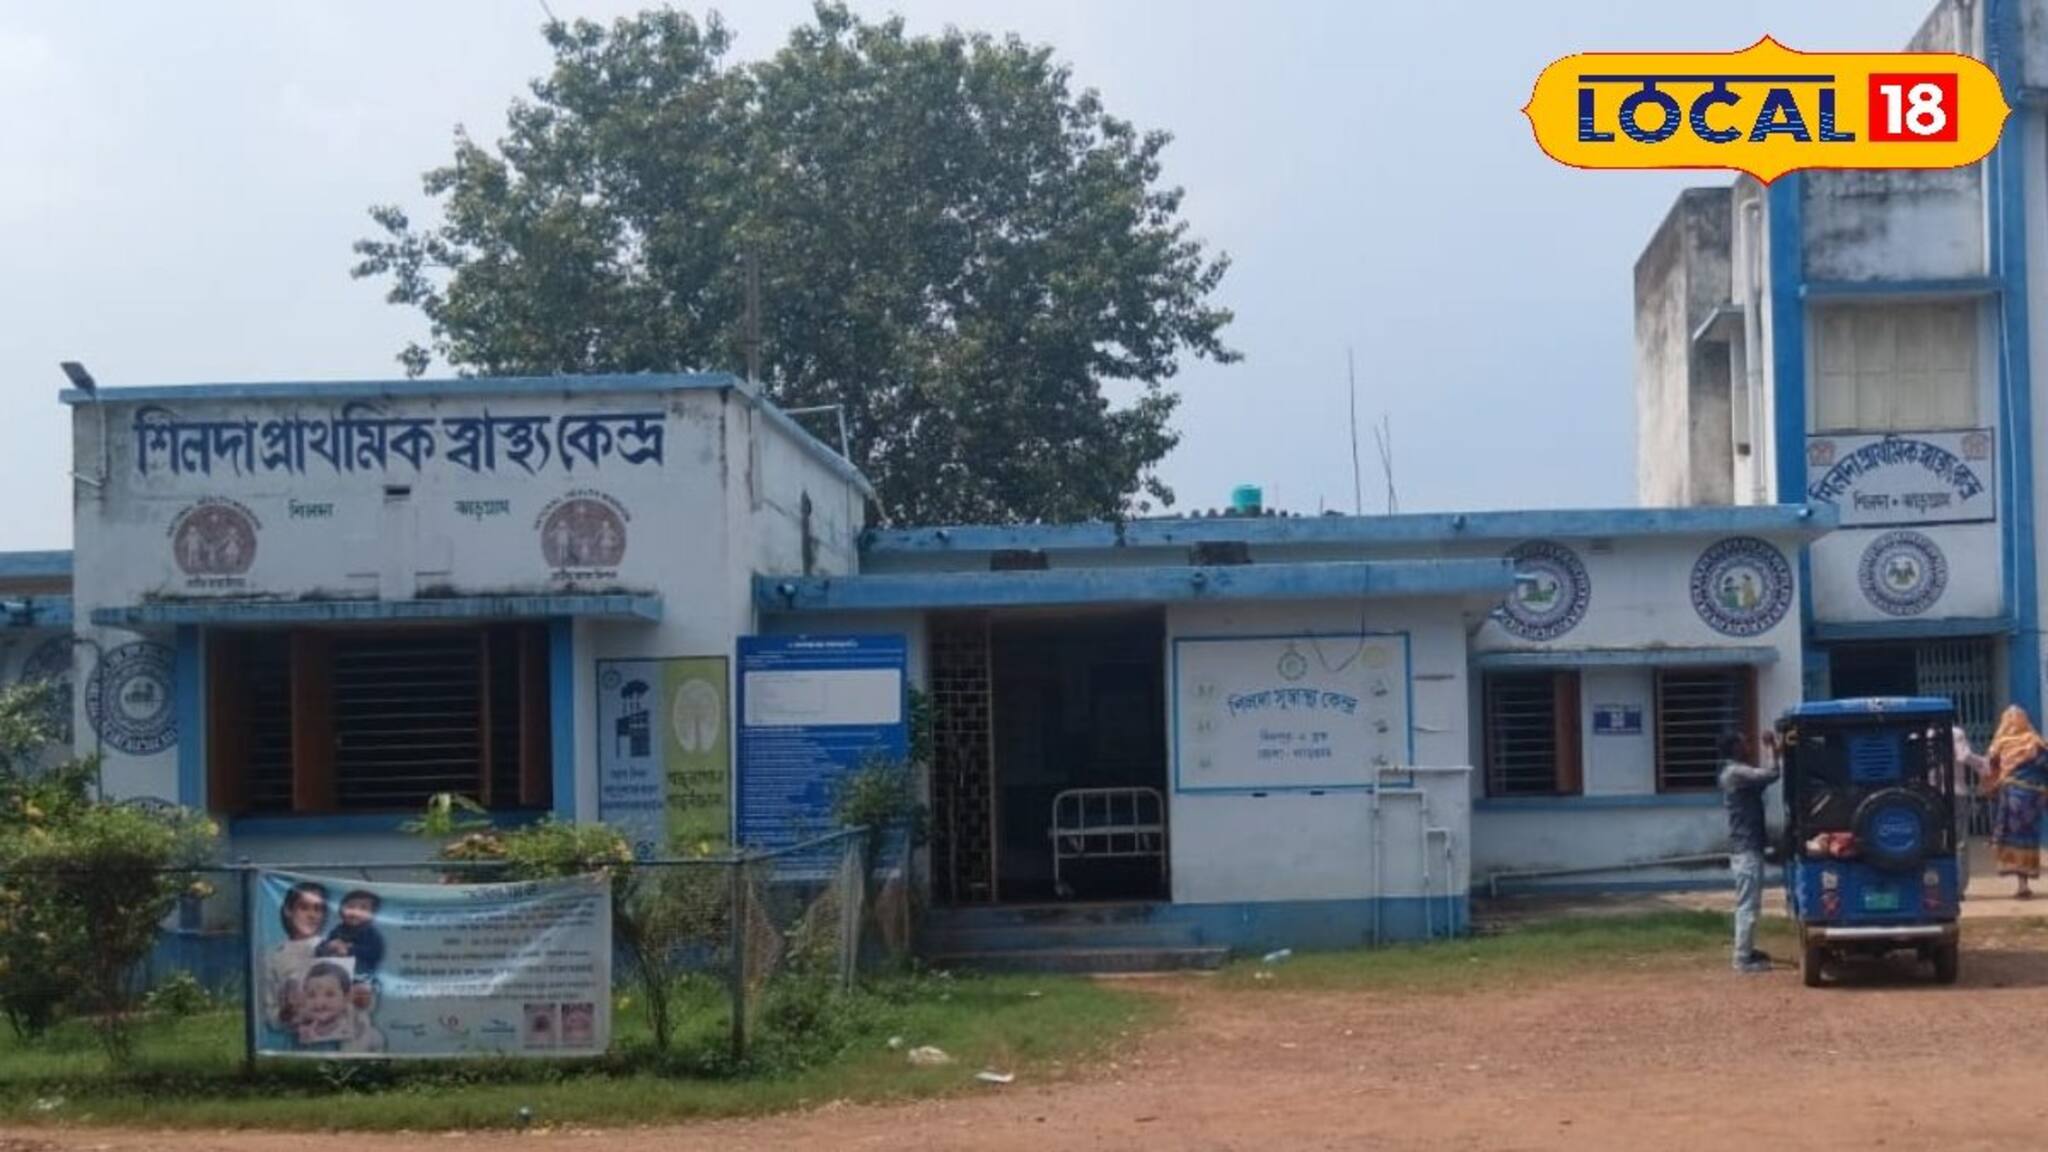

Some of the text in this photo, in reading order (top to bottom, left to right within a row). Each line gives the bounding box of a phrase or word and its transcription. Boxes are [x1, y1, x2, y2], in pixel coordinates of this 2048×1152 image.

[132, 400, 666, 477] শিলদা প্রাথমিক স্বাস্থ্য কেন্দ্র
